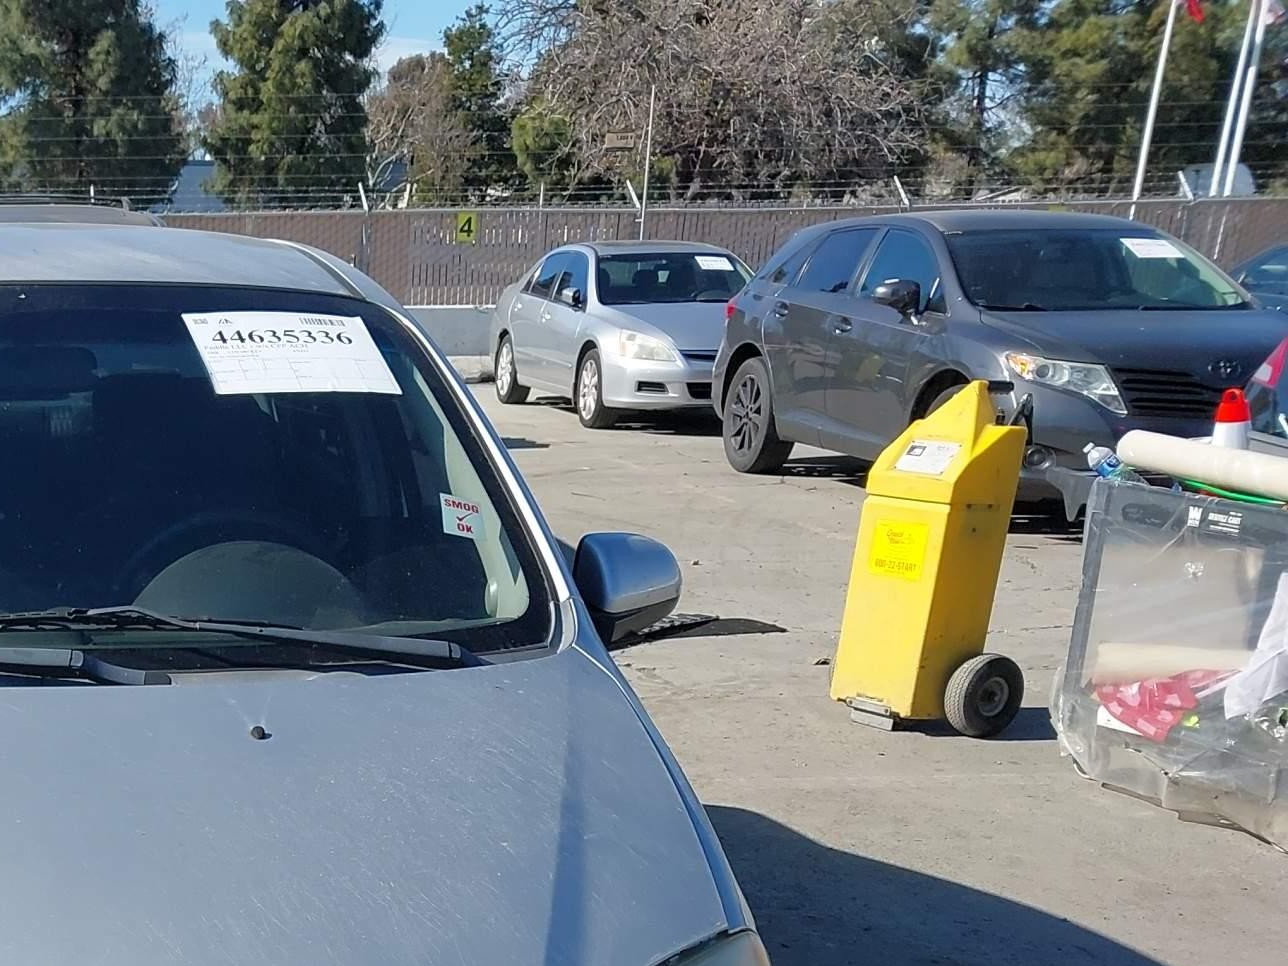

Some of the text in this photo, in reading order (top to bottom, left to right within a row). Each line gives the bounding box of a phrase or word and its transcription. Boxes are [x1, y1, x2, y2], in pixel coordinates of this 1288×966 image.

[459, 216, 473, 238] 4
[212, 329, 353, 345] 44635336
[444, 499, 479, 514] SMOG
[456, 523, 474, 534] OK
